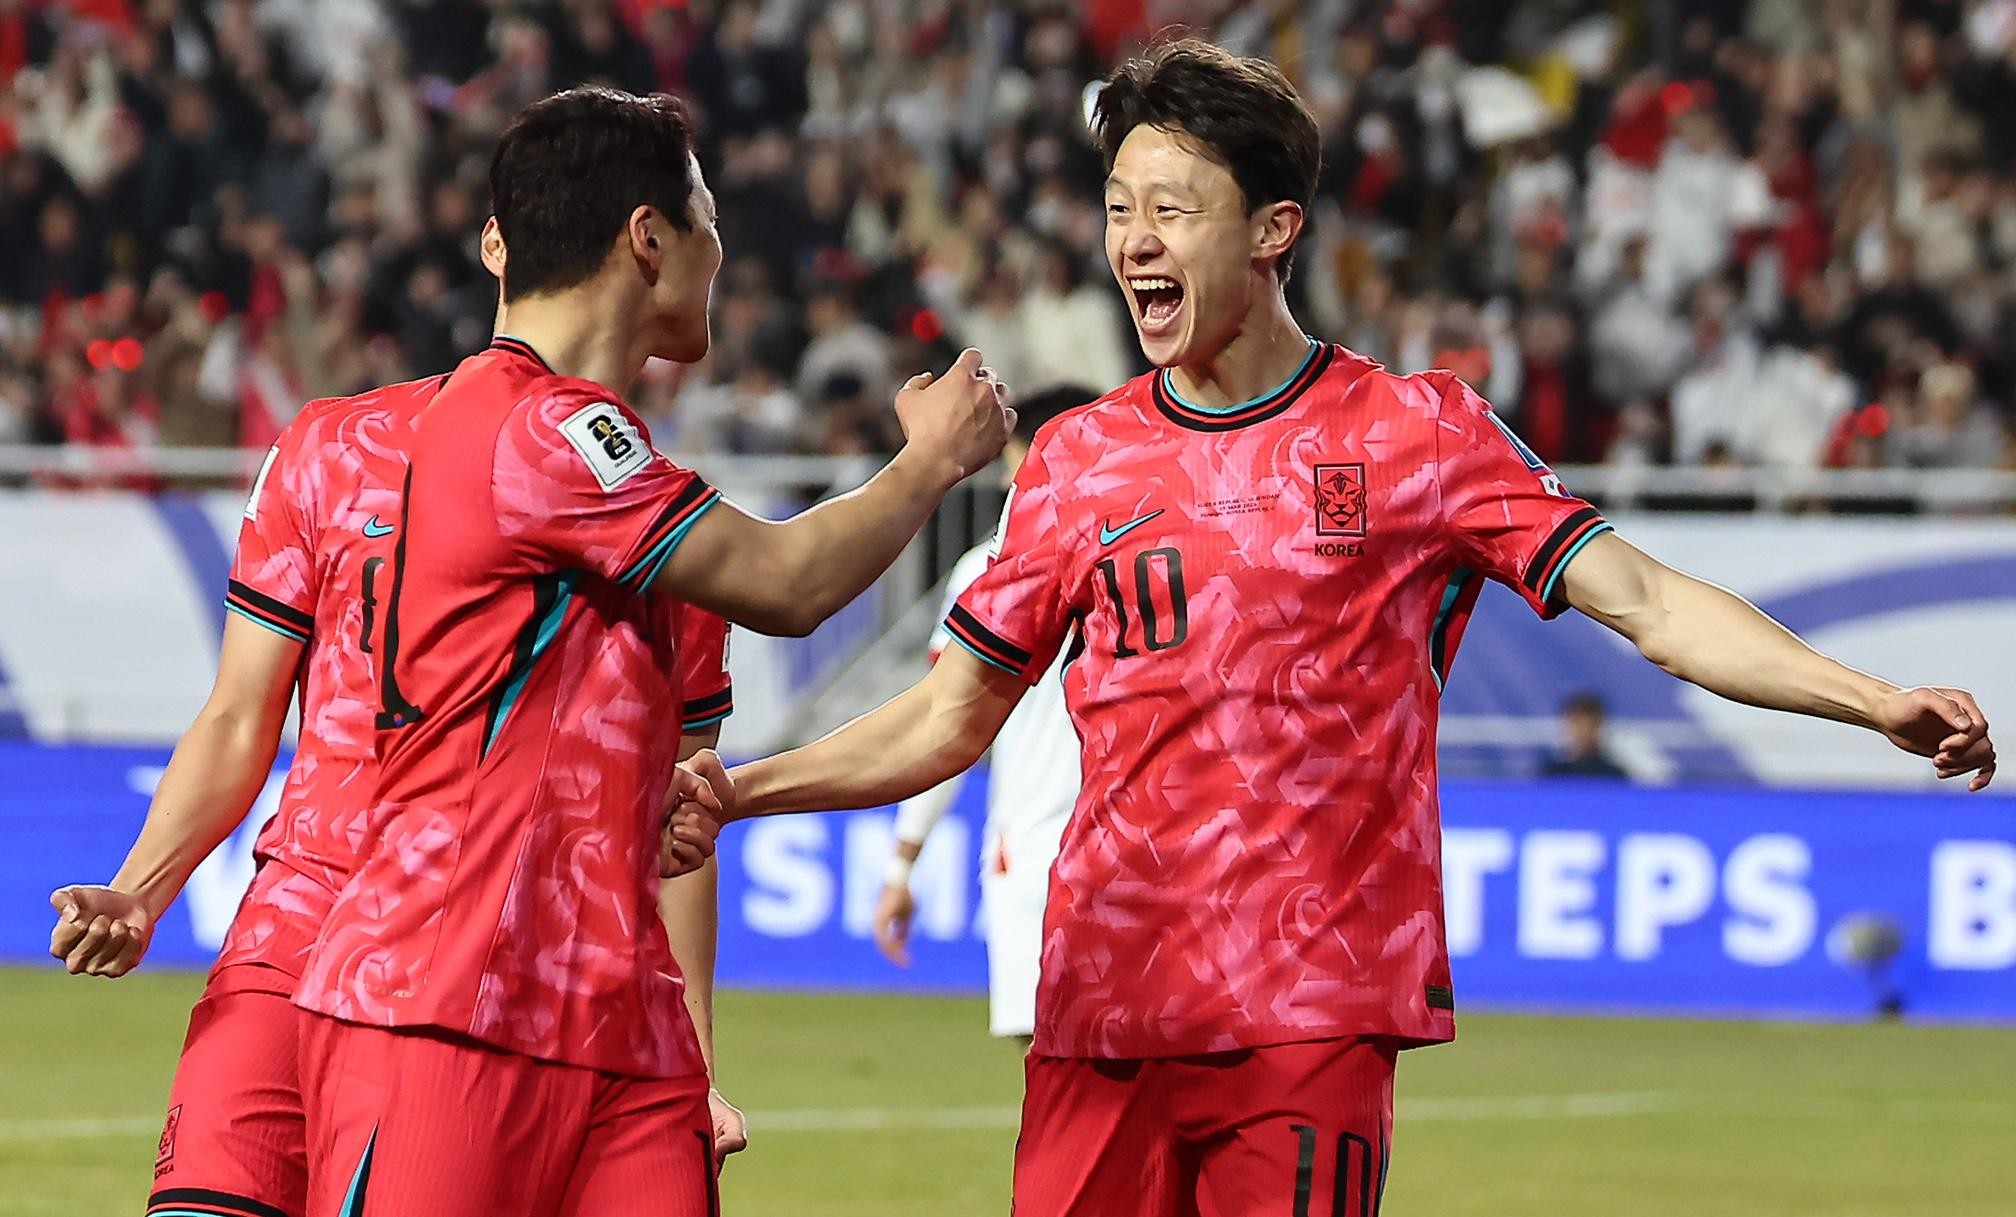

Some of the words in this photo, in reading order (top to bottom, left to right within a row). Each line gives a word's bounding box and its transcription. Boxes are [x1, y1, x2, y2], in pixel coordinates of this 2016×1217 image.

[1314, 543, 1365, 557] KOREA
[1096, 547, 1188, 659] 10
[741, 814, 985, 942] SM
[1289, 1123, 1372, 1217] 10
